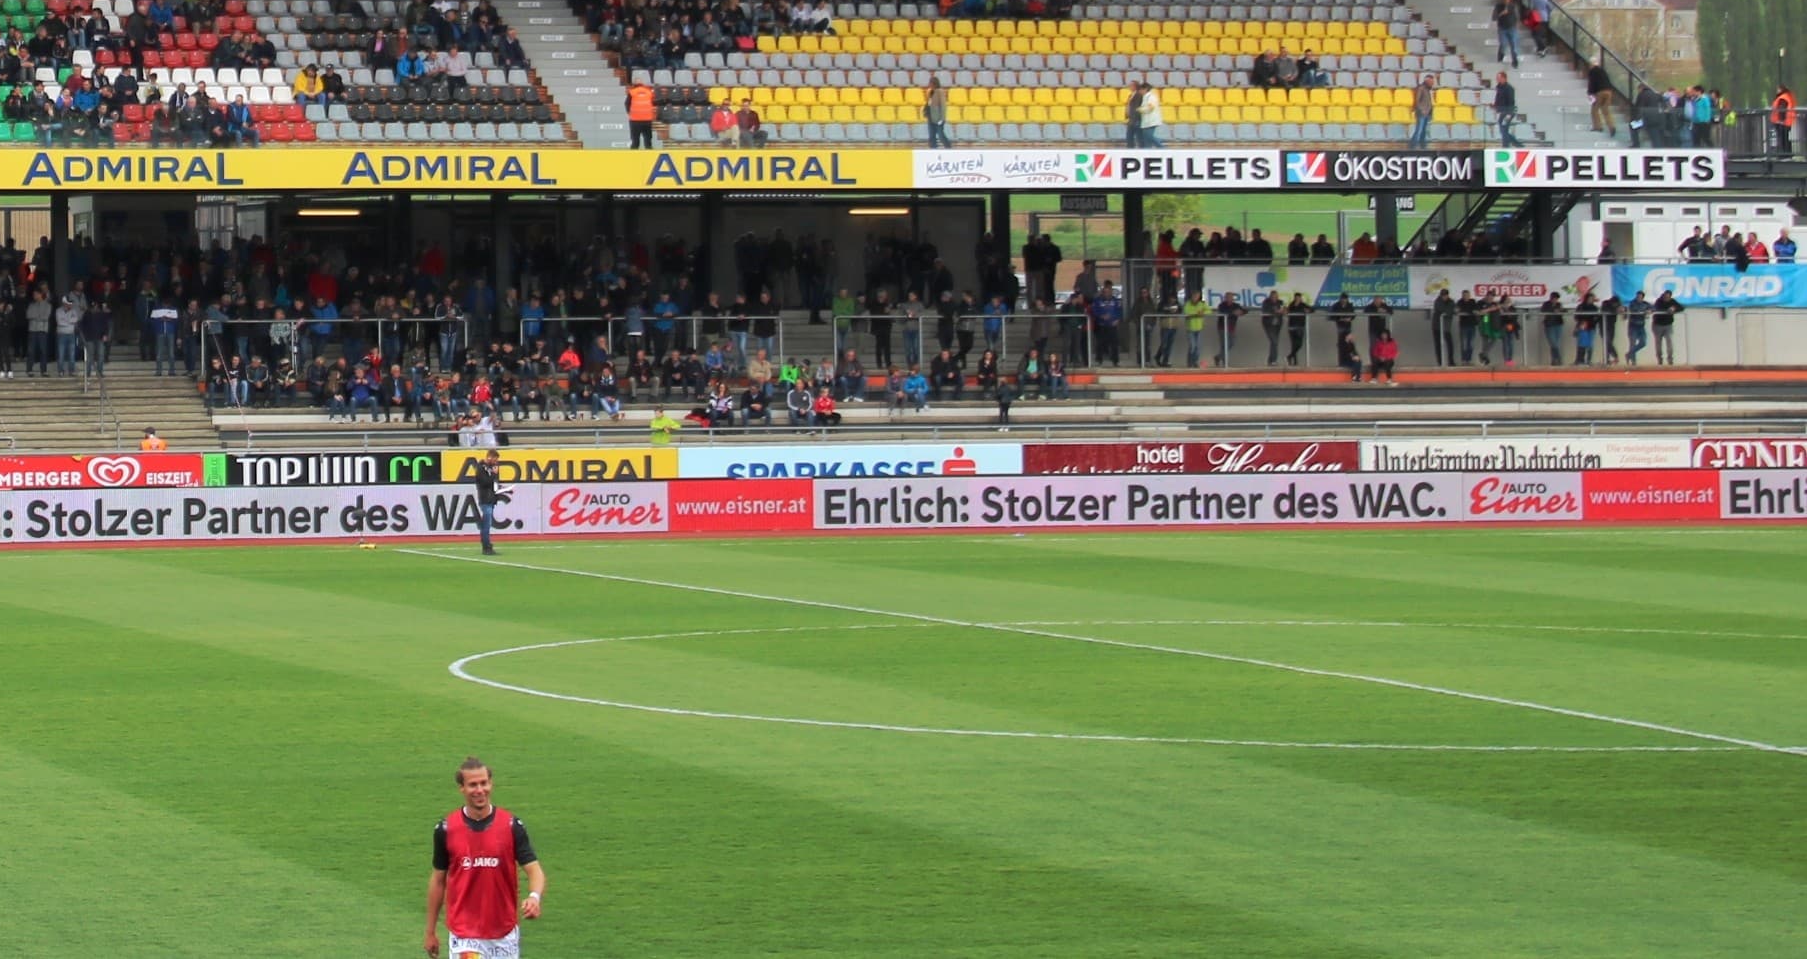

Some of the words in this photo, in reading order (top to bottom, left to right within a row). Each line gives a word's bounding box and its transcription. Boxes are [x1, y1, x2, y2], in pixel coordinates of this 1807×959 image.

[22, 152, 244, 187] ADMIRAL
[341, 152, 557, 186] ADMIRAL
[645, 152, 857, 185] ADMIRAL
[949, 174, 982, 184] SPORT
[1026, 174, 1059, 184] SPORT
[1120, 156, 1271, 181] PELLETS
[1334, 152, 1472, 181] ÖKOSTROM
[1544, 154, 1715, 183] PELLETS
[1476, 283, 1545, 297] SORGER
[1643, 268, 1784, 299] CONRAD
[1137, 445, 1184, 464] hotel
[145, 471, 192, 485] EISZEIT
[1509, 483, 1547, 494] AUTO
[548, 487, 663, 527] Eisner
[588, 493, 631, 505] AUTO
[675, 495, 806, 515] www.eisner.at
[823, 484, 970, 525] Ehrlich:
[981, 484, 1117, 524] Stolzer
[1127, 484, 1263, 522] Partner
[1273, 482, 1339, 520] des
[1349, 481, 1447, 519] WAC.
[1469, 476, 1579, 516] Eisner
[1589, 484, 1714, 505] www.eisner.at
[1729, 477, 1807, 515] Ehrl
[25, 498, 172, 539] Stolzer
[182, 498, 329, 536] Partner
[339, 494, 409, 533] des
[420, 493, 524, 531] WAC.
[472, 857, 500, 868] JAKO
